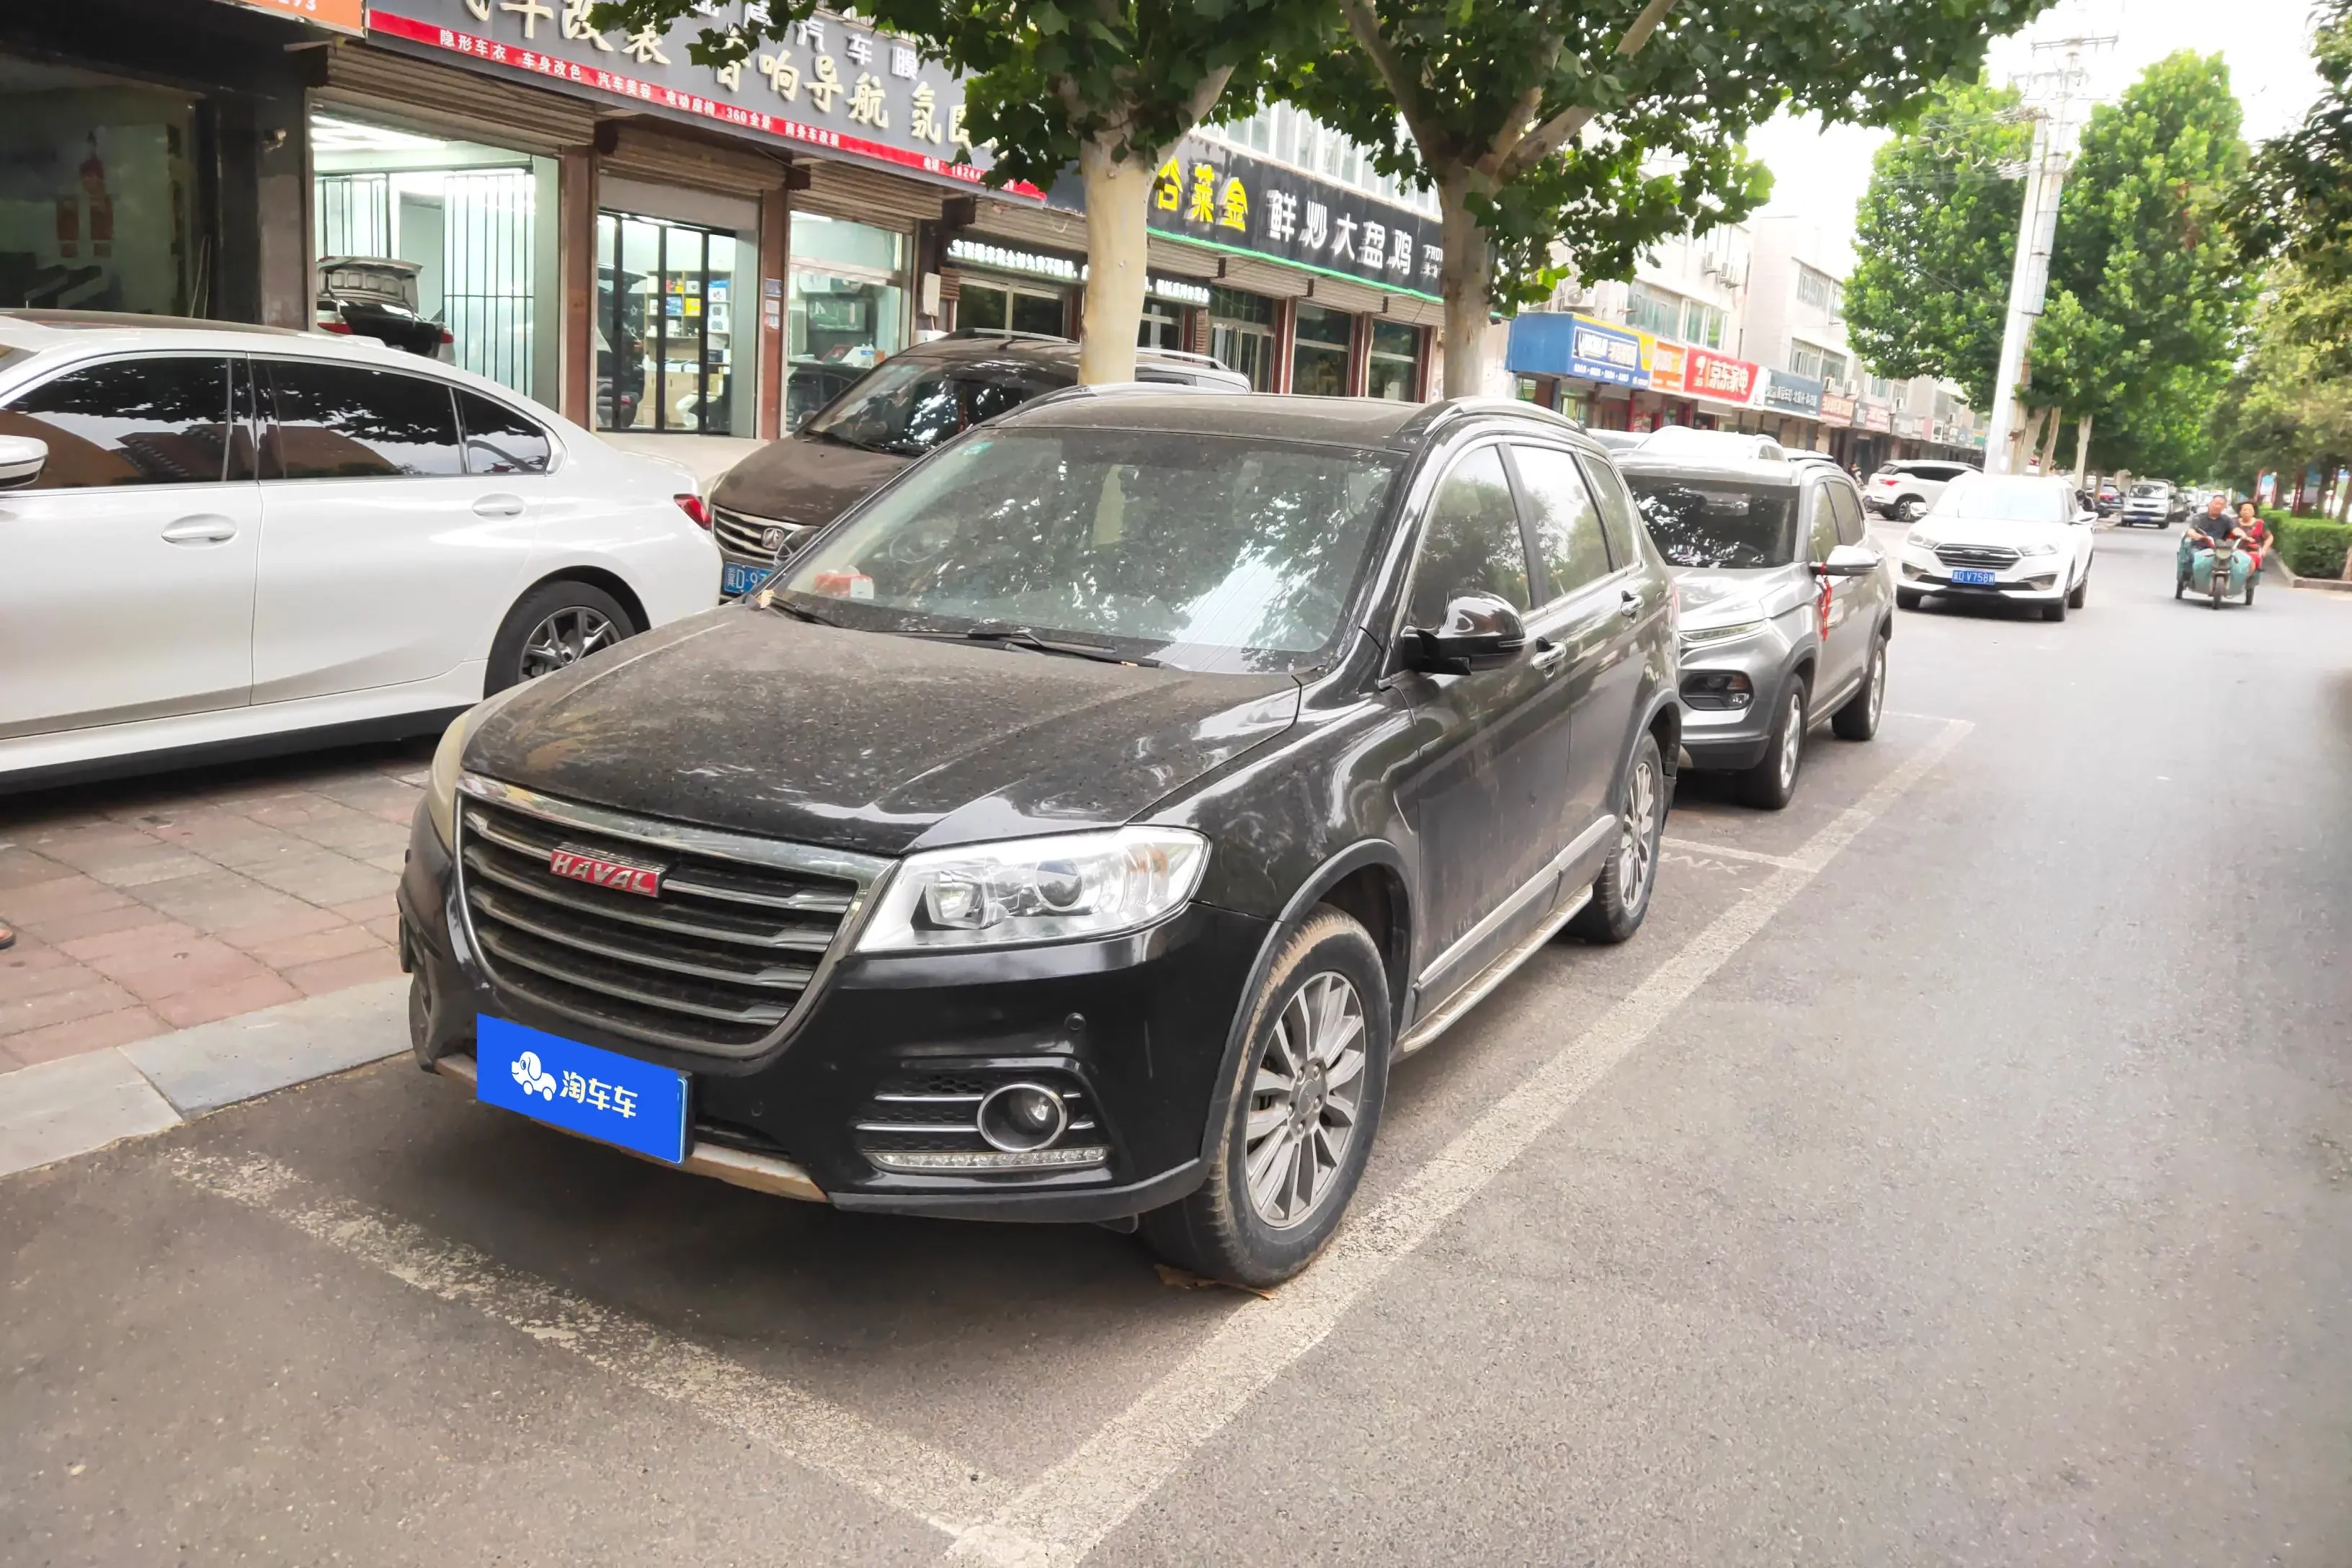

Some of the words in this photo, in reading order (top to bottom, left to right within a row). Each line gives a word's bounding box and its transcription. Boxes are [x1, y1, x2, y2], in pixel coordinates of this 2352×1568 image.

[440, 29, 507, 60] 隐形车衣
[522, 52, 582, 81] 车身改色
[597, 72, 651, 99] 汽车美容
[665, 89, 716, 117] 电动座椅
[726, 107, 772, 130] 360全景
[785, 121, 839, 148] 商务车改装
[1265, 189, 1412, 275] 鲜炒大盘鸡
[1709, 360, 1750, 396] 京东家电
[551, 854, 652, 893] HAVAL
